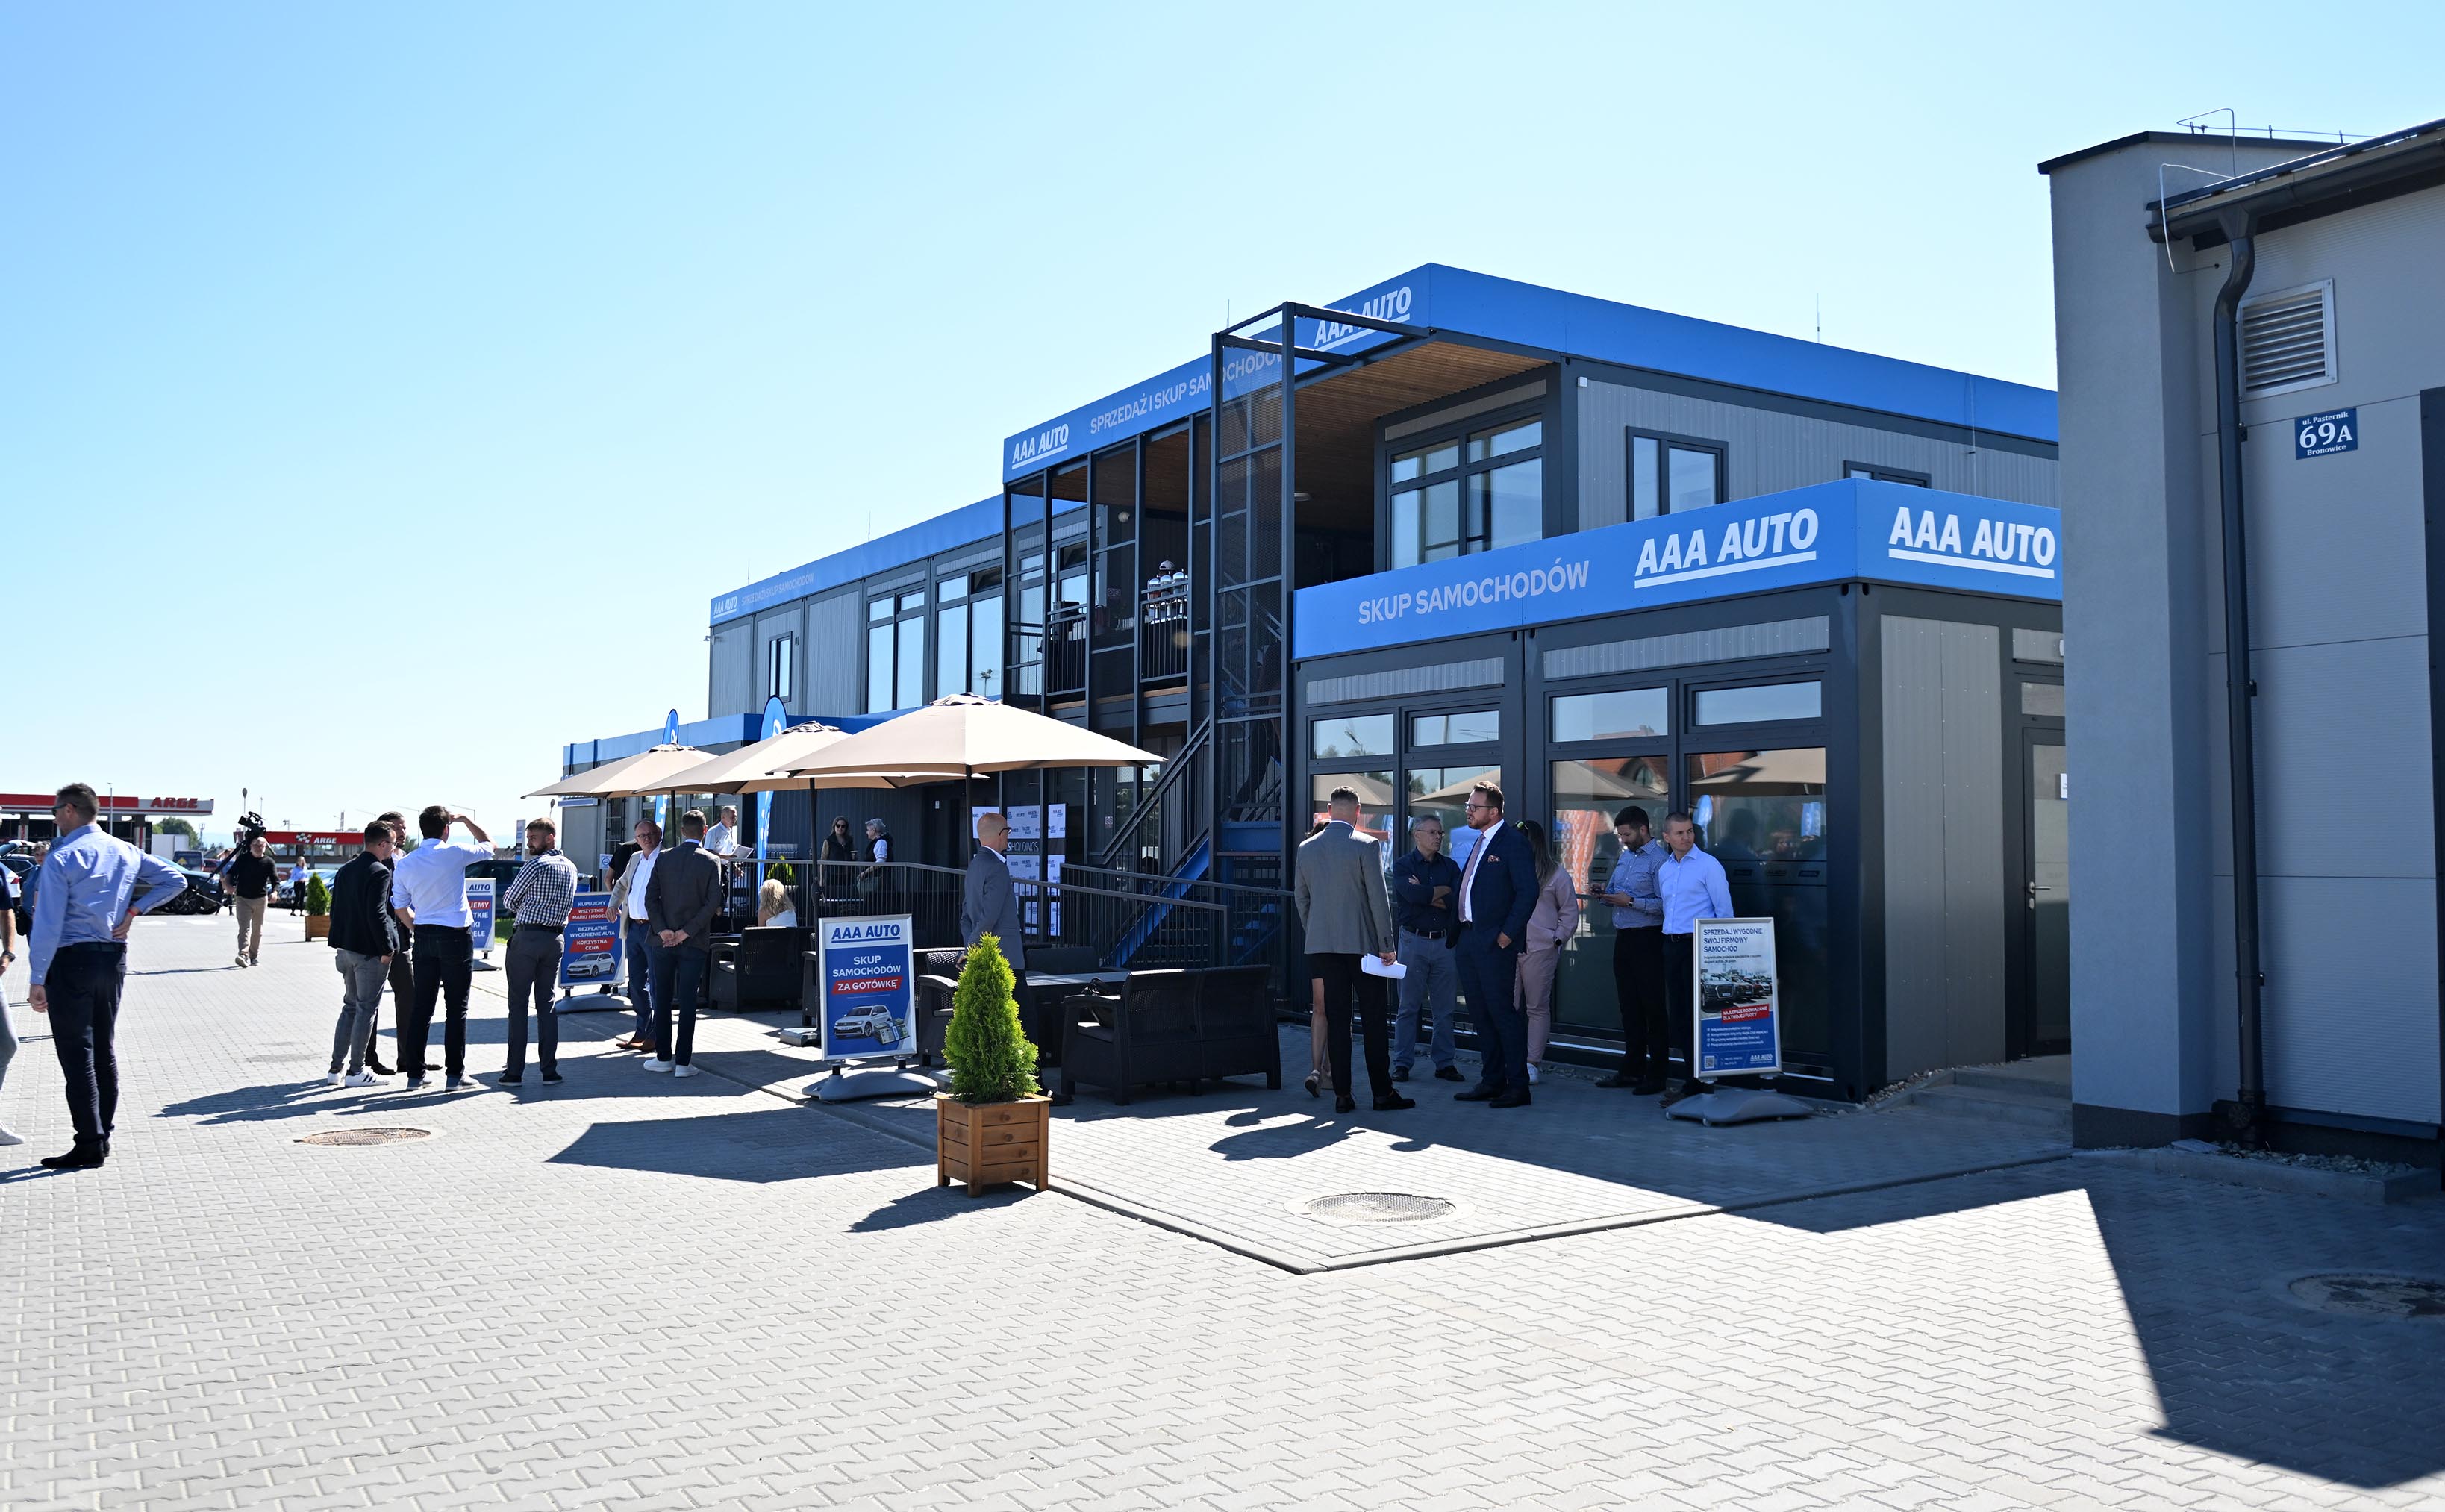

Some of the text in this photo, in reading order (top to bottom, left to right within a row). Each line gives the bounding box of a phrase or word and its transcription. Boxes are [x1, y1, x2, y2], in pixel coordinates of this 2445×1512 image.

[1358, 286, 1412, 329] AUTO
[1090, 393, 1148, 434] SPRZEDAŻ
[1149, 395, 1153, 411] I
[1155, 382, 1187, 410] SKUP
[2312, 411, 2349, 424] Pasternik
[1011, 423, 1070, 463] AAA AUTO
[2299, 422, 2353, 449] 69A
[2307, 445, 2346, 456] Bronowice
[1634, 508, 1819, 577] AAA AUTO
[1888, 506, 2056, 566] AAA AUTO
[1358, 557, 1590, 625] SKUP SAMOCHODÓW
[713, 596, 738, 616] AAA AUTO
[150, 797, 199, 809] ARGE
[831, 924, 901, 940] AAA AUTO
[832, 963, 902, 978] SAMOCHODÓW
[853, 955, 881, 966] SKUP
[837, 983, 851, 992] ZA
